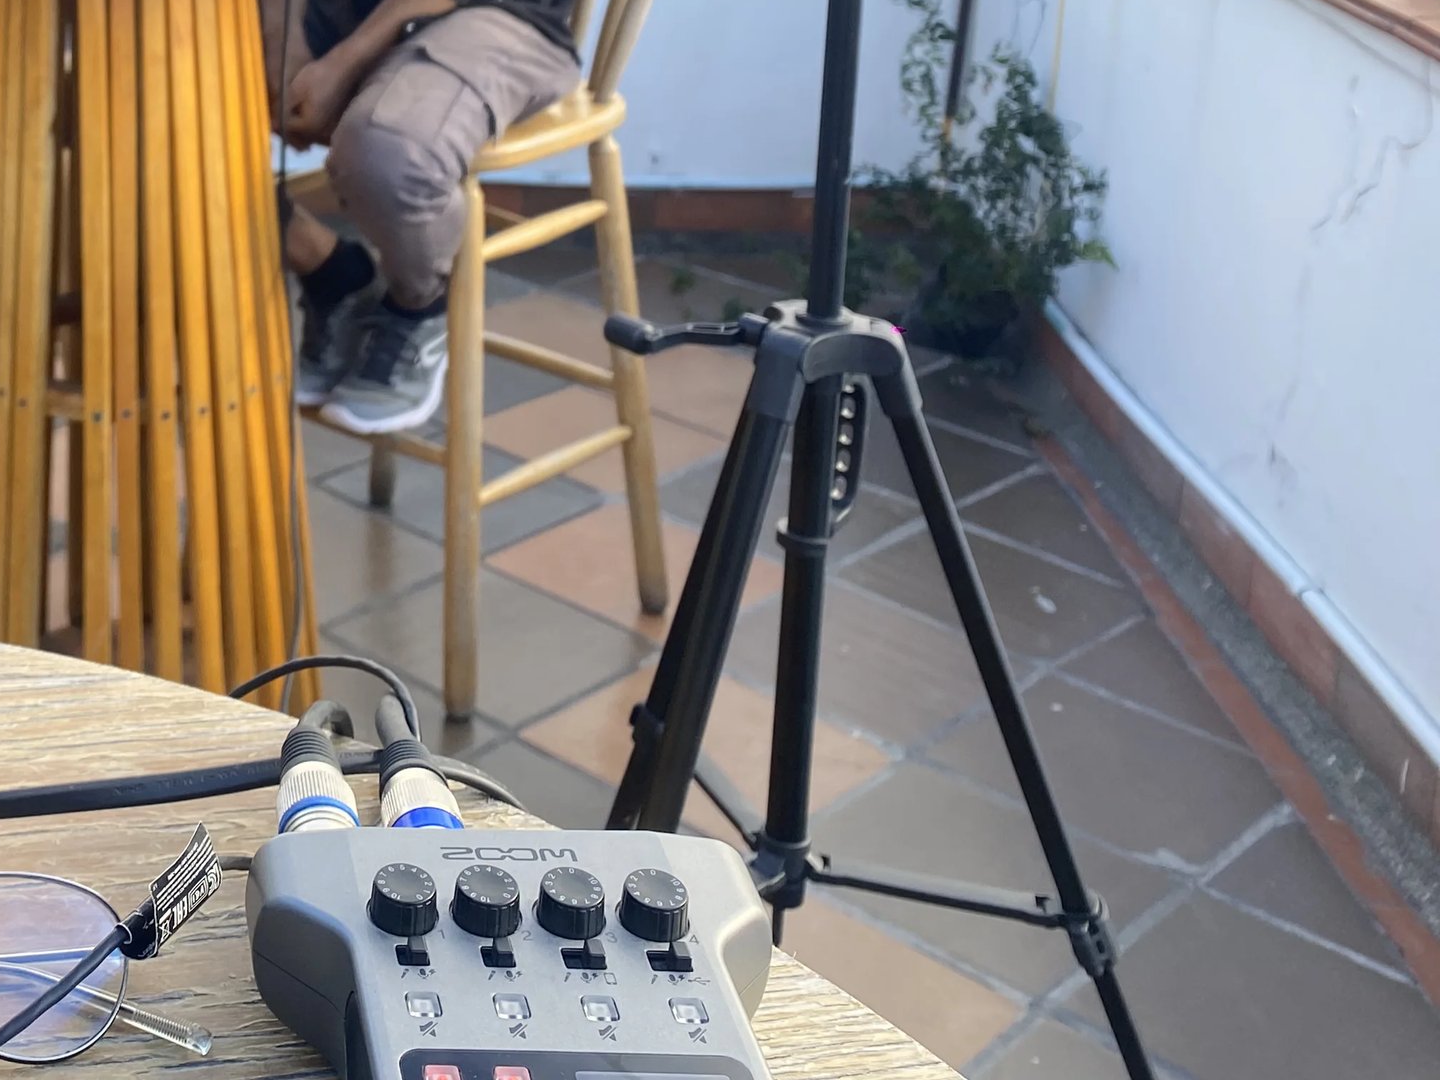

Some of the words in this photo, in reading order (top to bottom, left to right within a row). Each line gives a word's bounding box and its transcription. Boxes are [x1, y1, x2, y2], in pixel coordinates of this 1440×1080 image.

[440, 846, 577, 862] ZOOM
[438, 929, 445, 939] 1
[521, 930, 533, 941] 2
[605, 931, 617, 943] 3
[689, 934, 699, 944] 4
